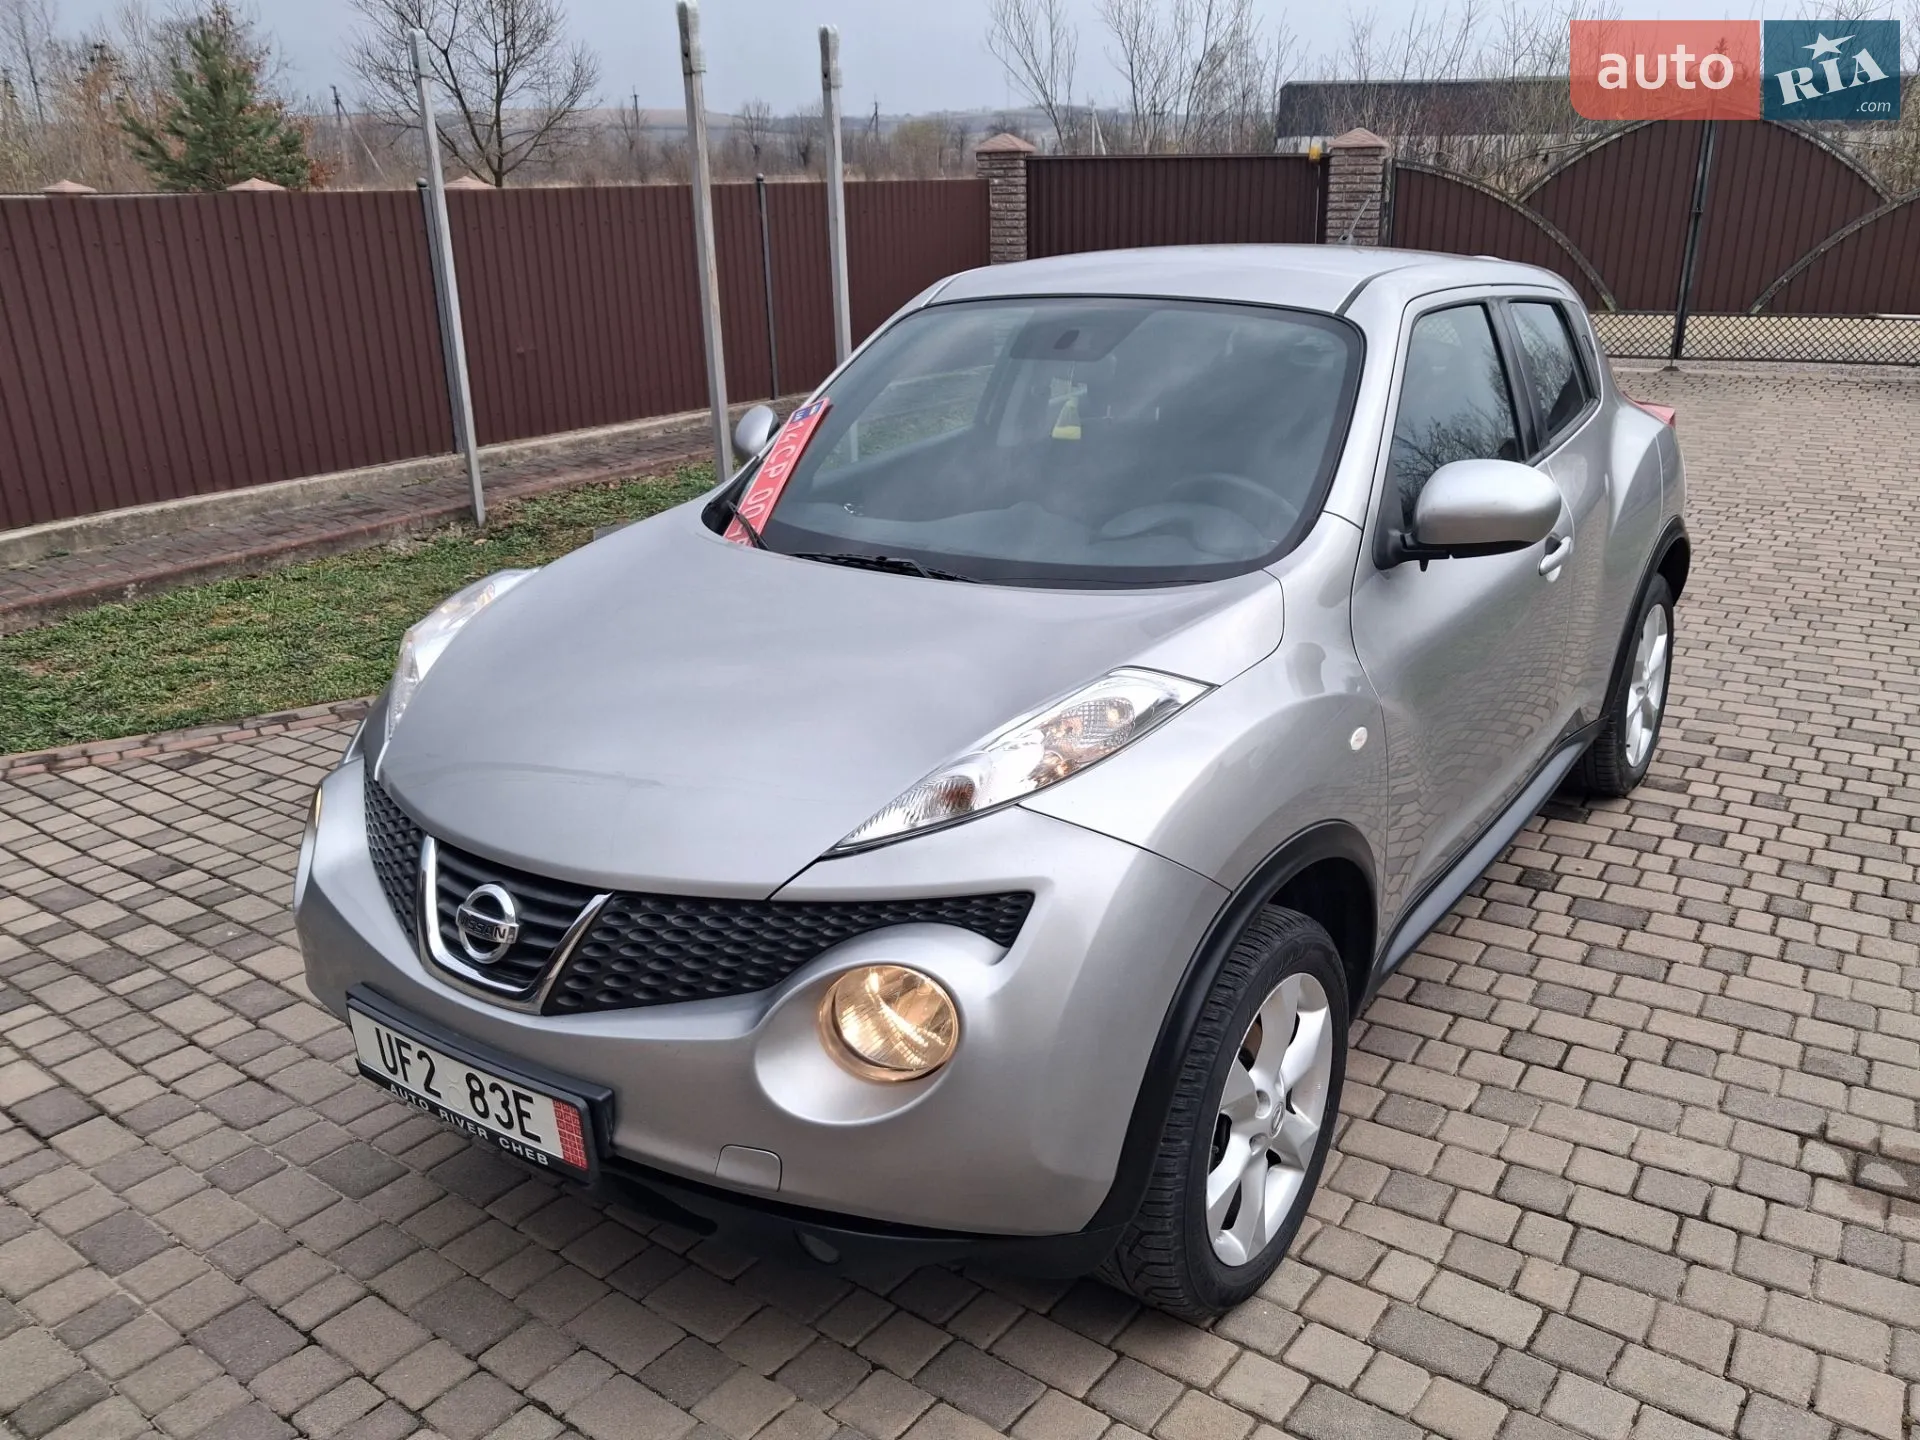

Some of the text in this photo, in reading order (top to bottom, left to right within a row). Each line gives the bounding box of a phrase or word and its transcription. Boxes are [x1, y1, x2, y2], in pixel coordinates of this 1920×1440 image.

[375, 1027, 442, 1100] UF2
[465, 1072, 542, 1143] 83E
[389, 1083, 549, 1166] AUTO RIVER CHEB
